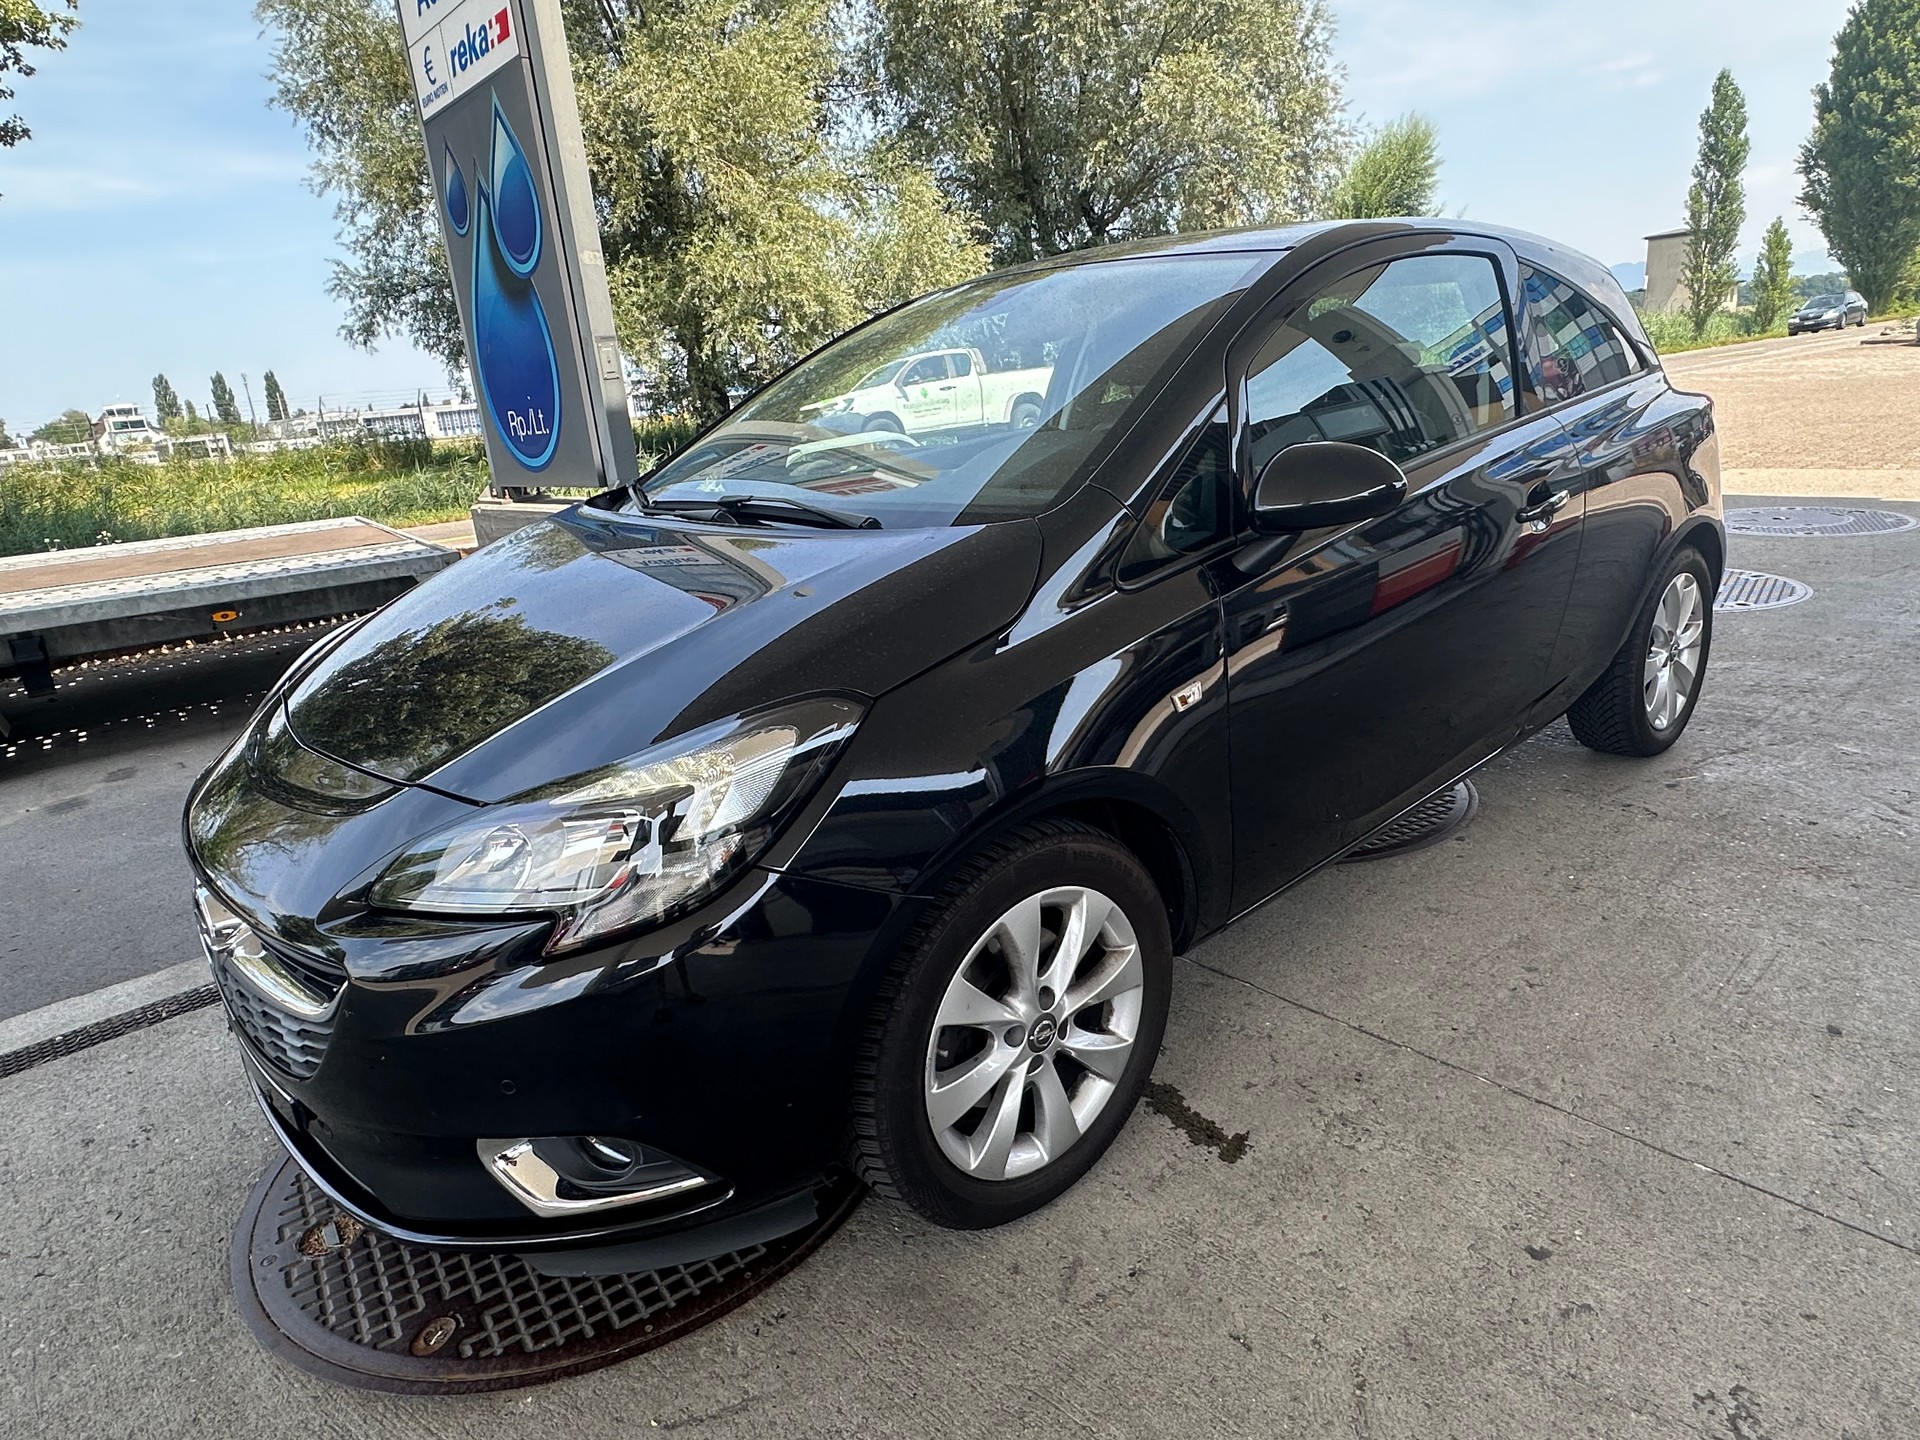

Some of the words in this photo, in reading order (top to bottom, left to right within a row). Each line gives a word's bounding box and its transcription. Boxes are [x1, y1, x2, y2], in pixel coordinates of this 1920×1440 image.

[421, 92, 435, 109] EURO
[433, 82, 449, 99] NOTEN
[507, 408, 550, 442] Rp./Lt.
